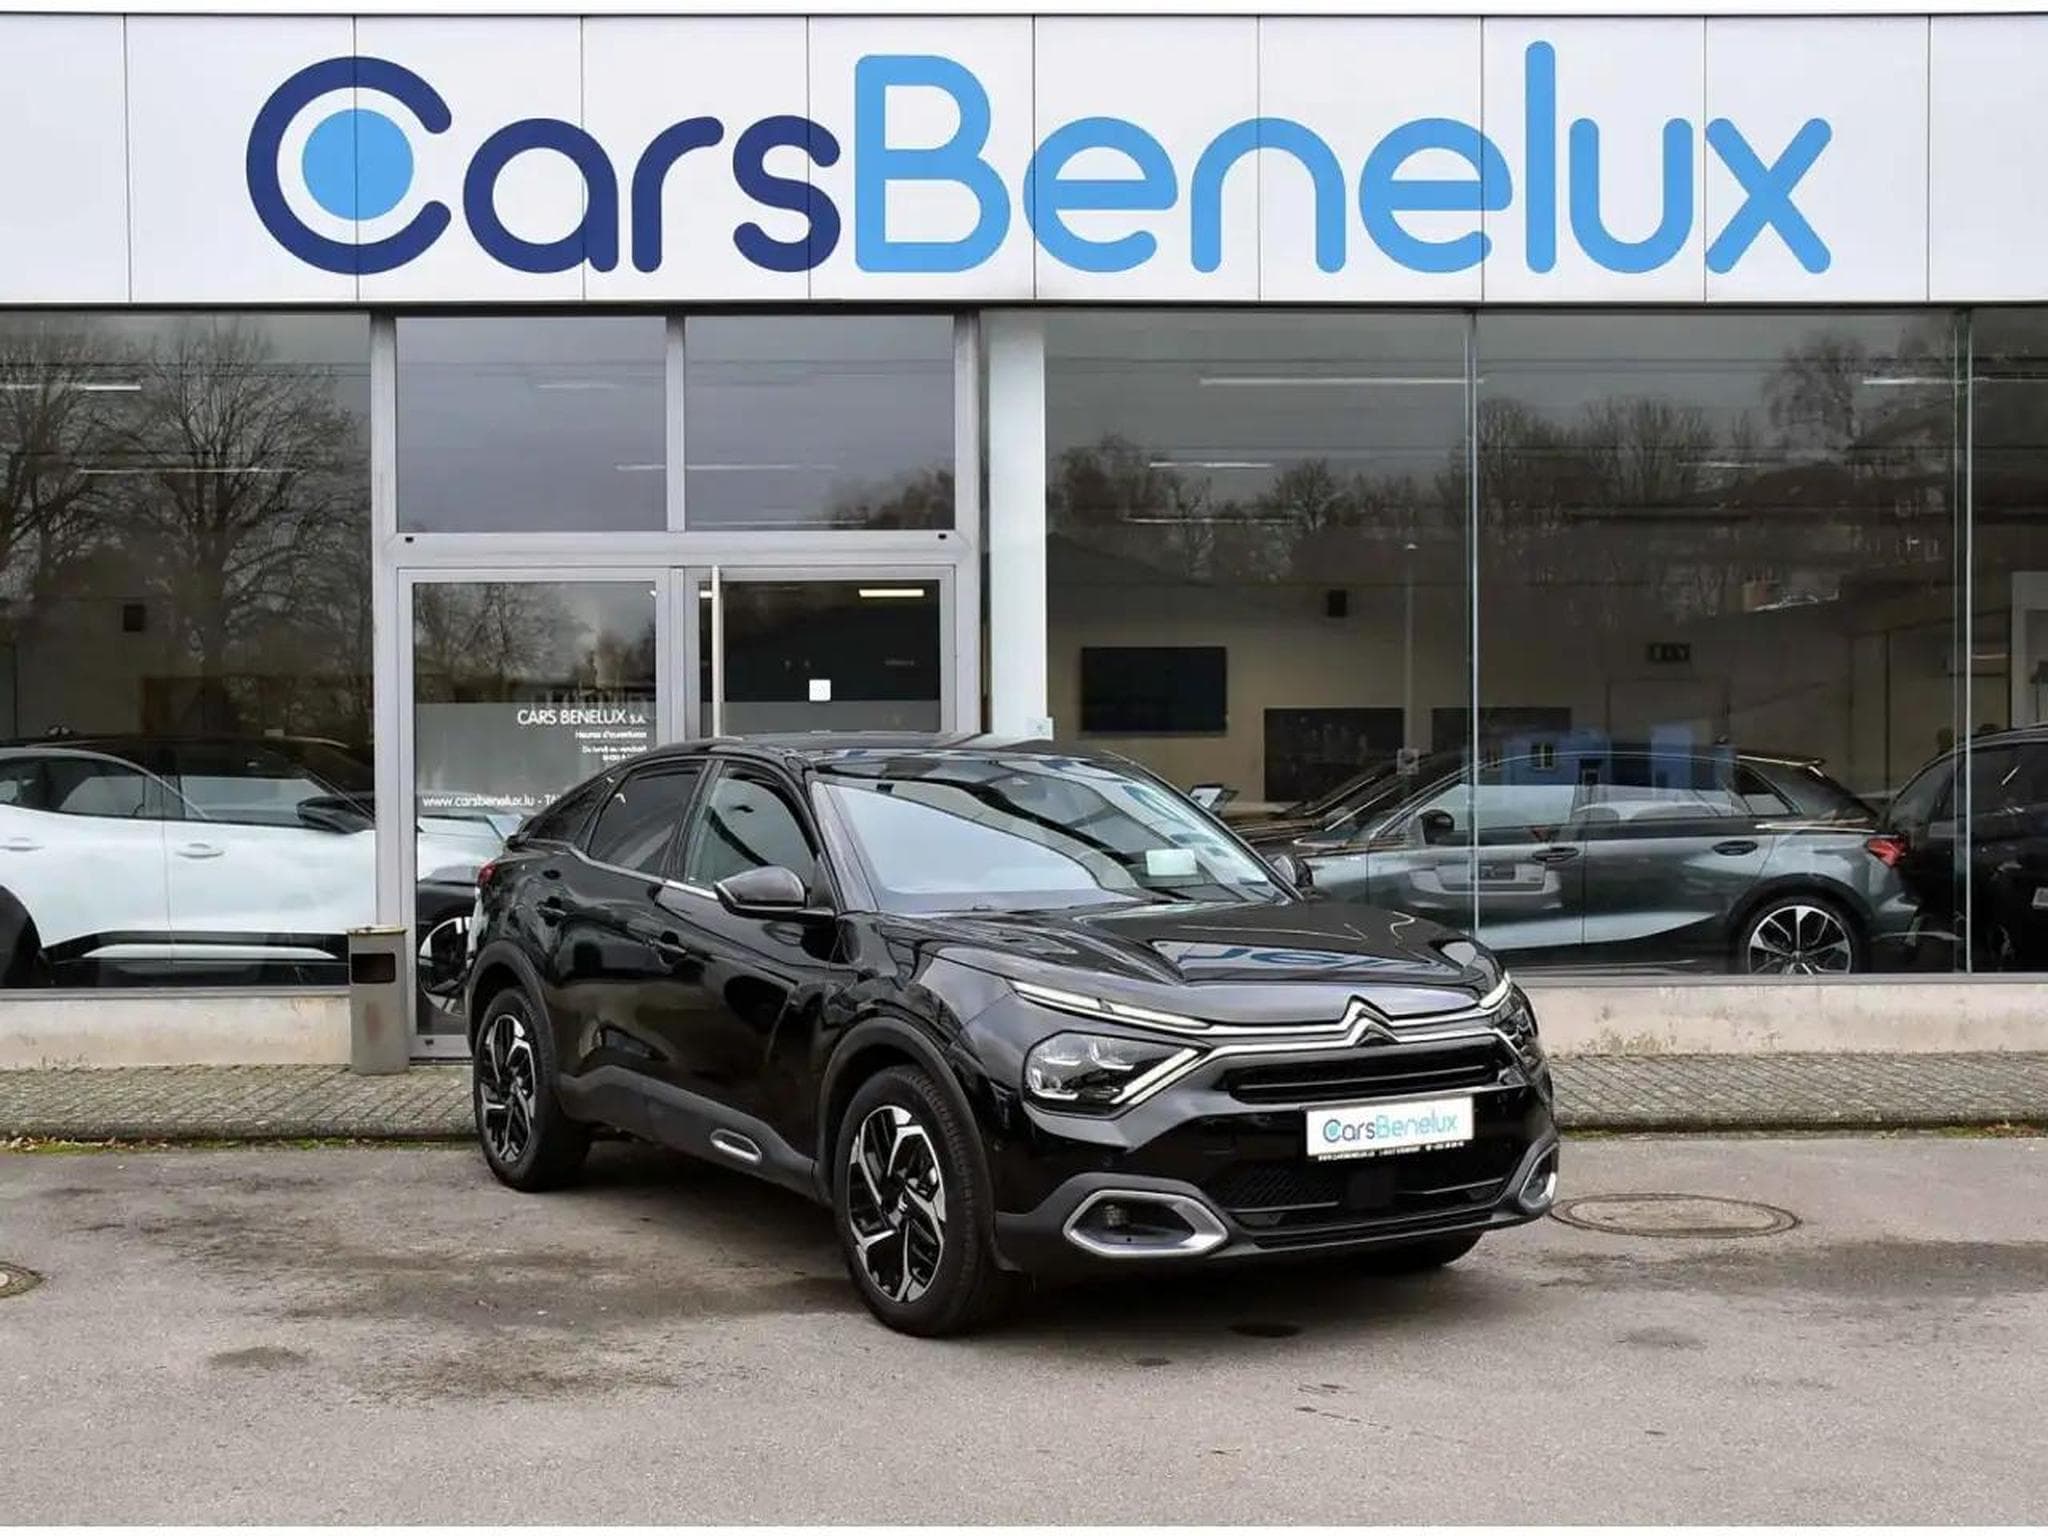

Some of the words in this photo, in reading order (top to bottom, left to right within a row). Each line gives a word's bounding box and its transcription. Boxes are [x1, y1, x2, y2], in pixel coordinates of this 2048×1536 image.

[247, 40, 1832, 274] CarsBenelux
[517, 709, 557, 724] CARS
[560, 709, 627, 724] BENELUX
[422, 793, 534, 807] www.carsbenelux.lu
[1322, 1109, 1459, 1143] CarsBenelux
